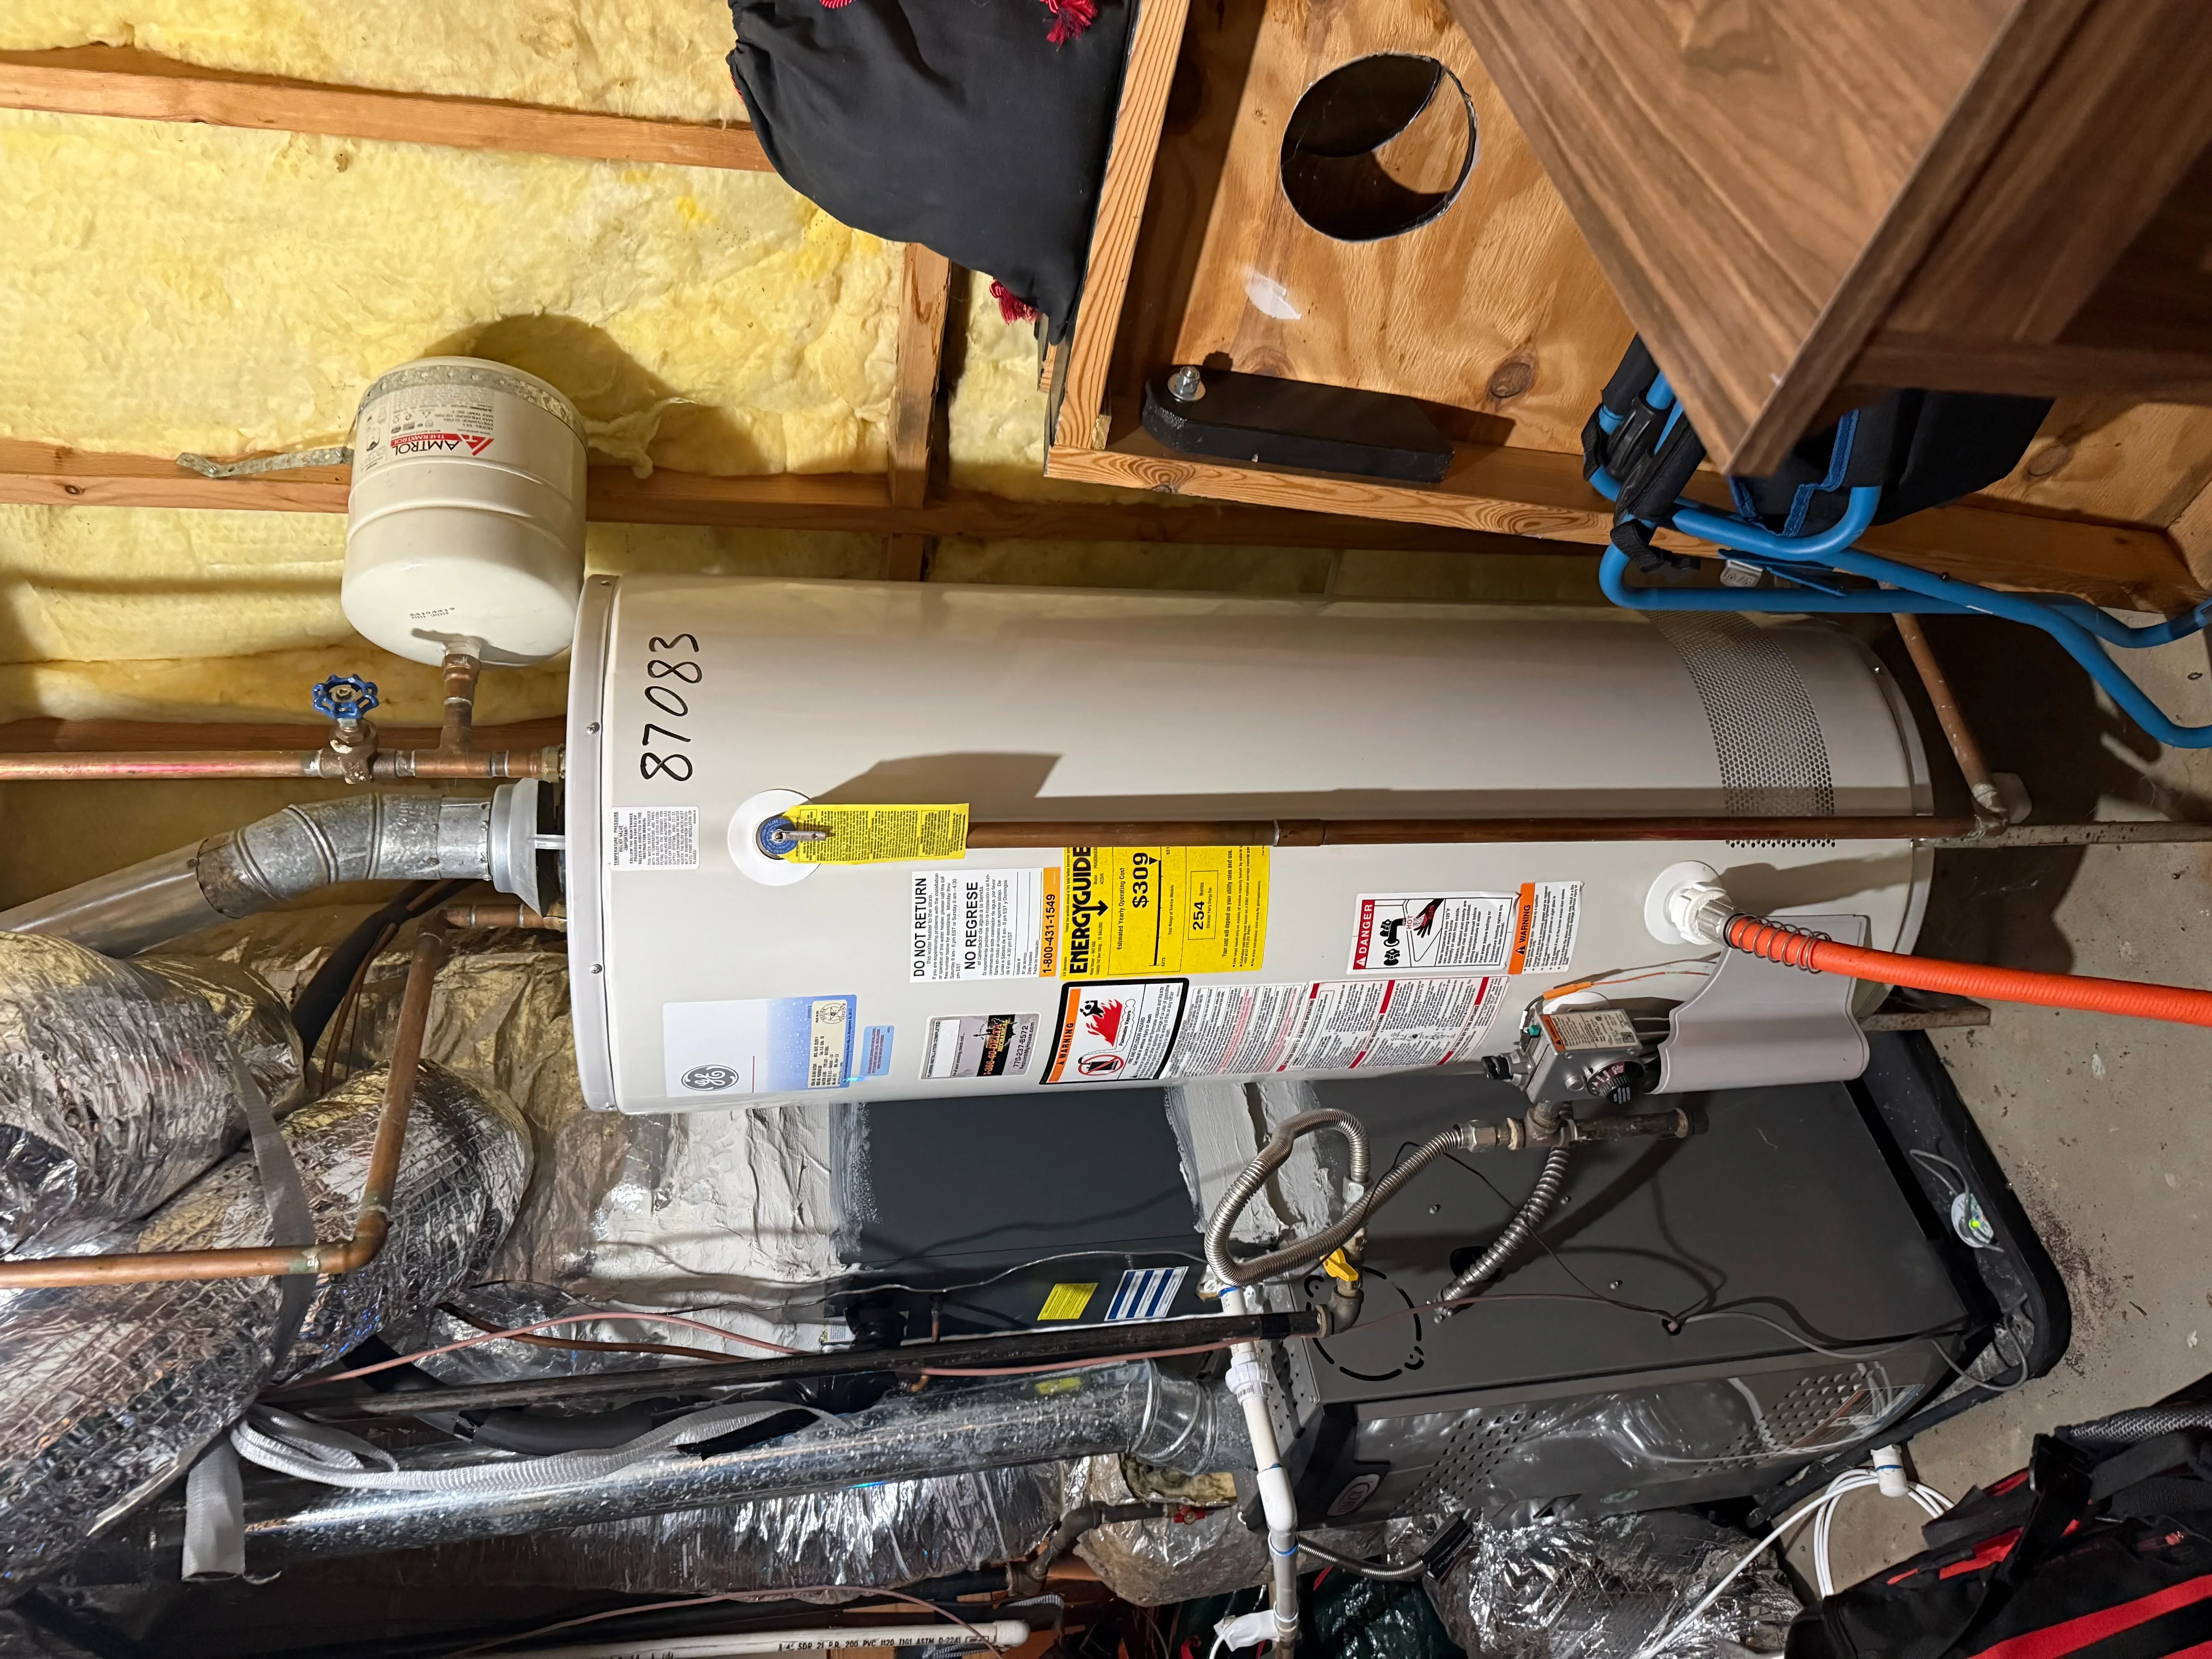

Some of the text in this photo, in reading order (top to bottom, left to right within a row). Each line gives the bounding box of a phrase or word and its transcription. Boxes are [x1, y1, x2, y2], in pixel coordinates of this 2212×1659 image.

[395, 440, 460, 455] AMTROL
[640, 634, 702, 781] 87083
[1130, 853, 1151, 908] $309
[913, 878, 927, 977] DO NOT RETURN
[964, 882, 978, 969] NO REGRESE
[1069, 847, 1093, 974] ENERGYGUIDE
[1192, 901, 1205, 931] 254
[1358, 904, 1373, 954] DANGER
[1519, 905, 1530, 943] WARNING
[1042, 894, 1055, 974] 1-800-431-1549
[1483, 943, 1491, 963] showering.
[997, 1020, 1008, 1052] MECHANICAL
[1013, 1026, 1028, 1067] 770-237-8572
[1058, 1023, 1074, 1059] WARNING
[1119, 1026, 1128, 1046] Flammable
[1133, 1033, 1141, 1051] EXPLOSION
[1289, 1043, 1299, 1053] SAFETY
[1305, 1000, 1315, 1020] OPERATING
[983, 1024, 1002, 1075] 1-866-40-DELTA
[797, 1642, 812, 1650] SDR
